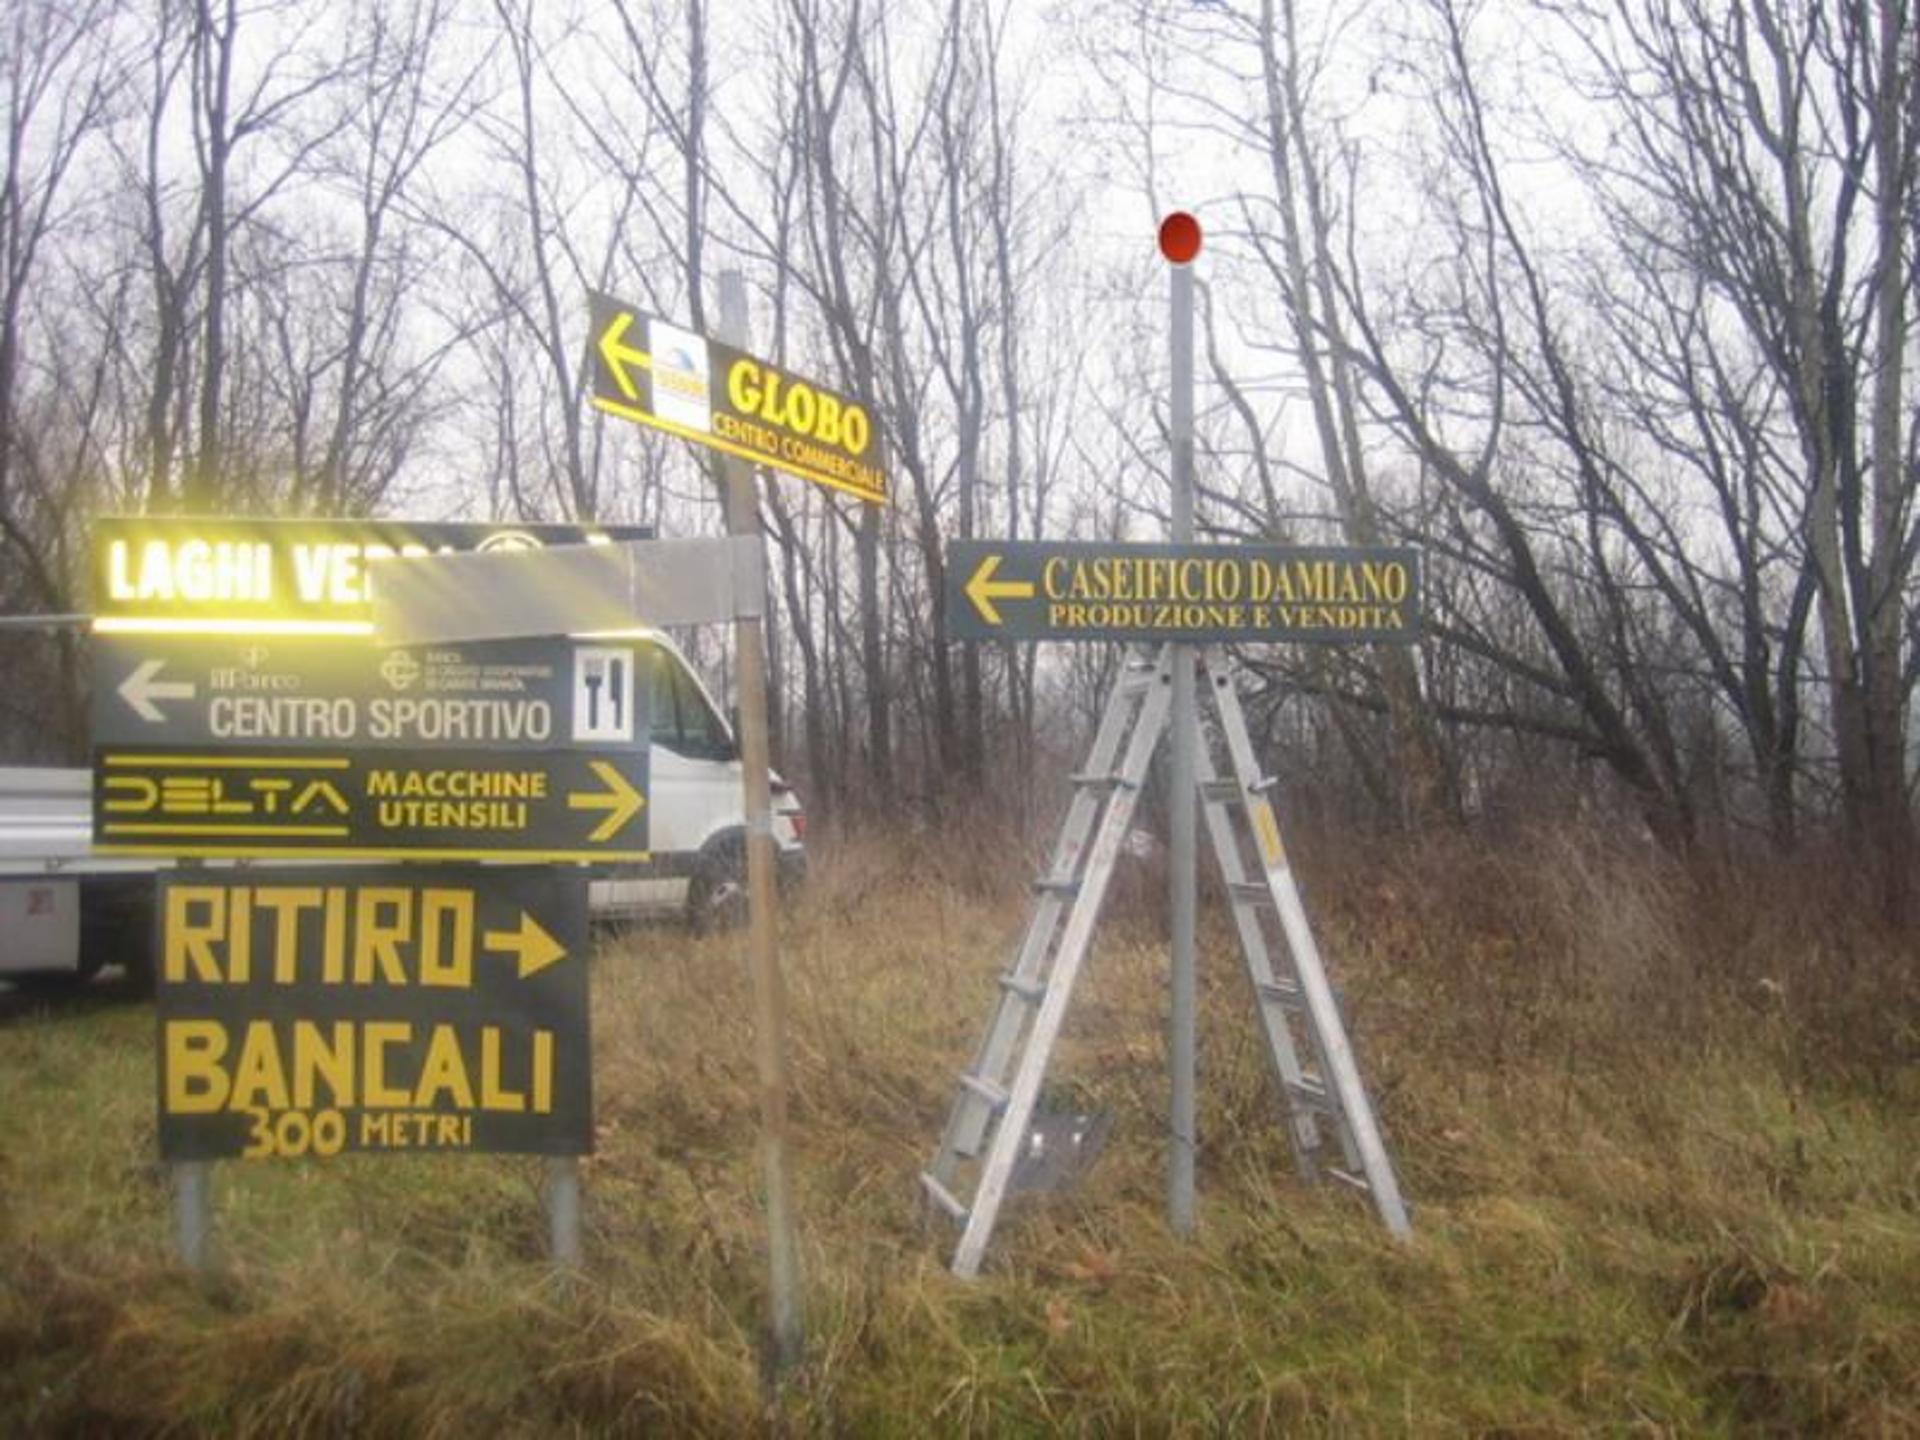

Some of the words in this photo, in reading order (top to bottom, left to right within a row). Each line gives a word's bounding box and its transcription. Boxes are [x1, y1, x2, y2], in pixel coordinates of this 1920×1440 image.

[728, 359, 869, 454] GLOBO
[712, 411, 778, 453] CENTRO
[109, 539, 272, 601] LAGHI
[1042, 556, 1241, 600] CASEIFICIO
[1250, 560, 1407, 602] DAMIANO
[1048, 604, 1245, 628] PRODUZIONE
[1254, 606, 1271, 628] E
[1281, 606, 1404, 630] VENDITA
[209, 700, 356, 739] CENTRO
[368, 700, 552, 741] SPORTIVO
[104, 776, 350, 814] DELTA
[366, 770, 547, 798] MACCHINE
[378, 801, 527, 829] UTENSILI
[165, 886, 474, 988] RITIRO
[165, 1019, 553, 1114] BANCALI
[242, 1106, 346, 1159] 300
[360, 1113, 472, 1147] METRI
